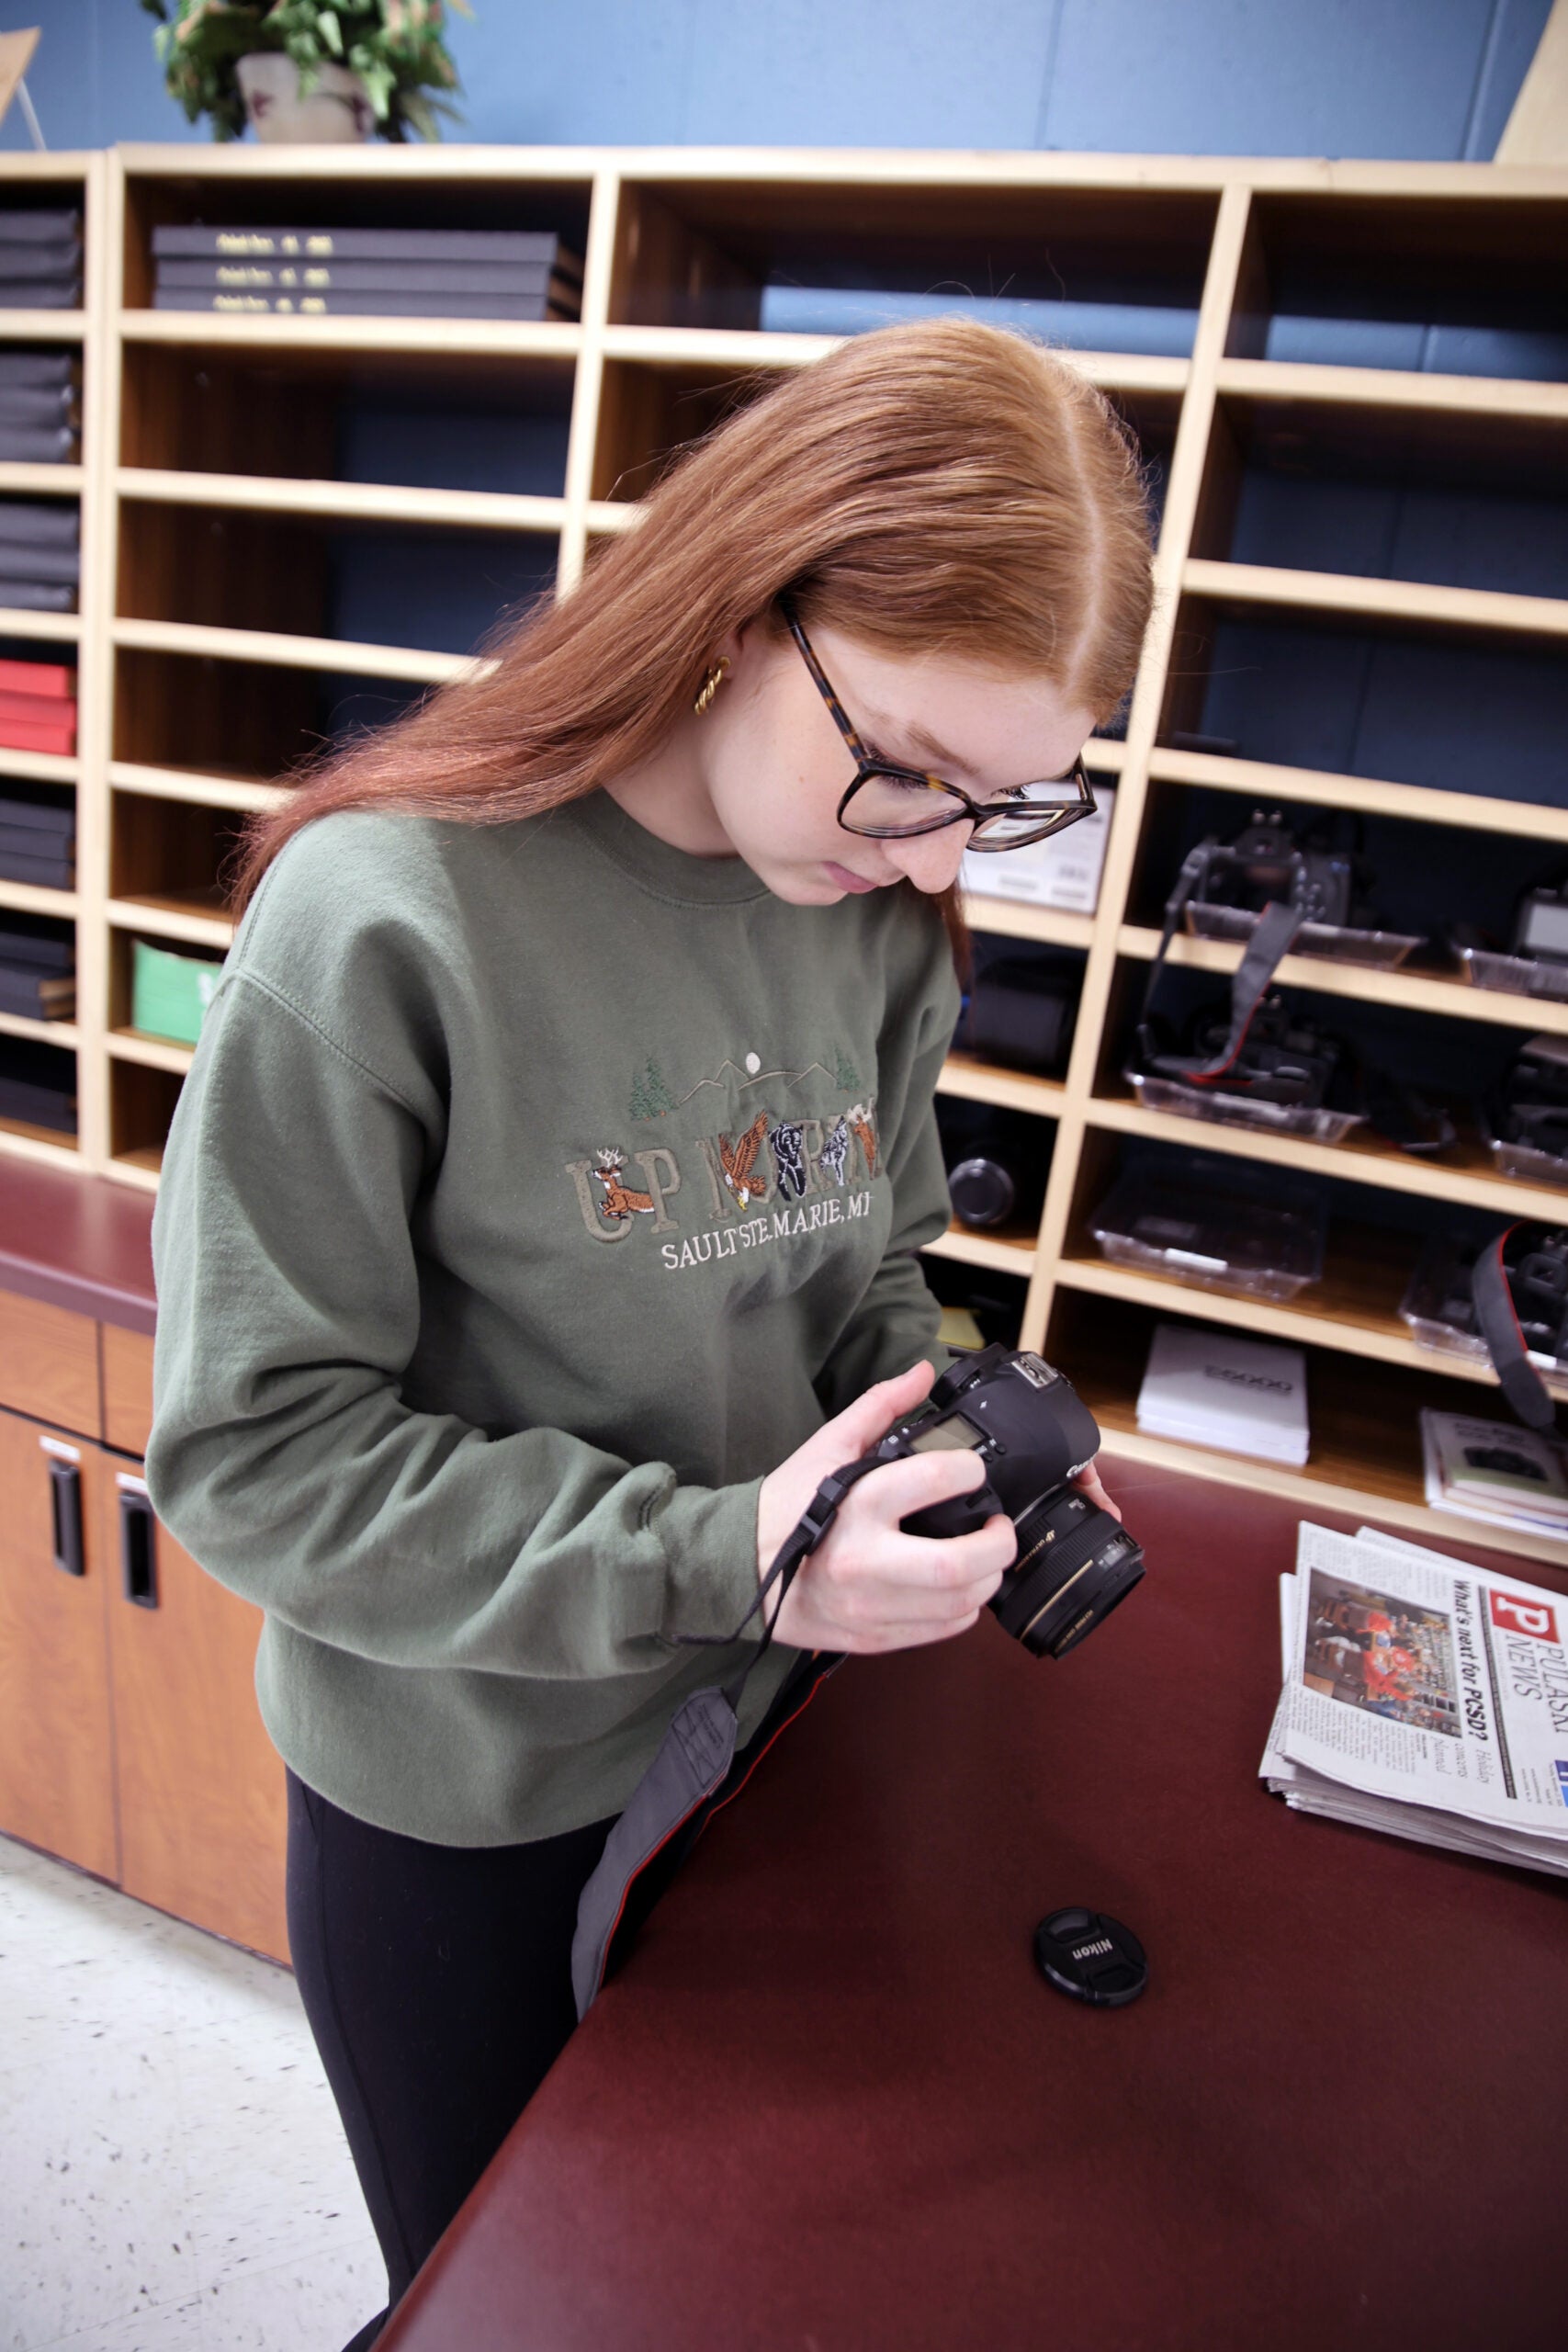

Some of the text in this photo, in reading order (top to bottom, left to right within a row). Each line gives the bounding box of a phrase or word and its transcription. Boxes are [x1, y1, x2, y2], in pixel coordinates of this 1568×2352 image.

[660, 1227, 739, 1270] SAULT
[847, 1192, 874, 1220] MI
[1497, 1596, 1551, 1634] P
[1453, 1579, 1488, 1740] What's next for PCSD?
[1506, 1634, 1542, 1702] NEWS
[1072, 1939, 1113, 1960] Nikon
